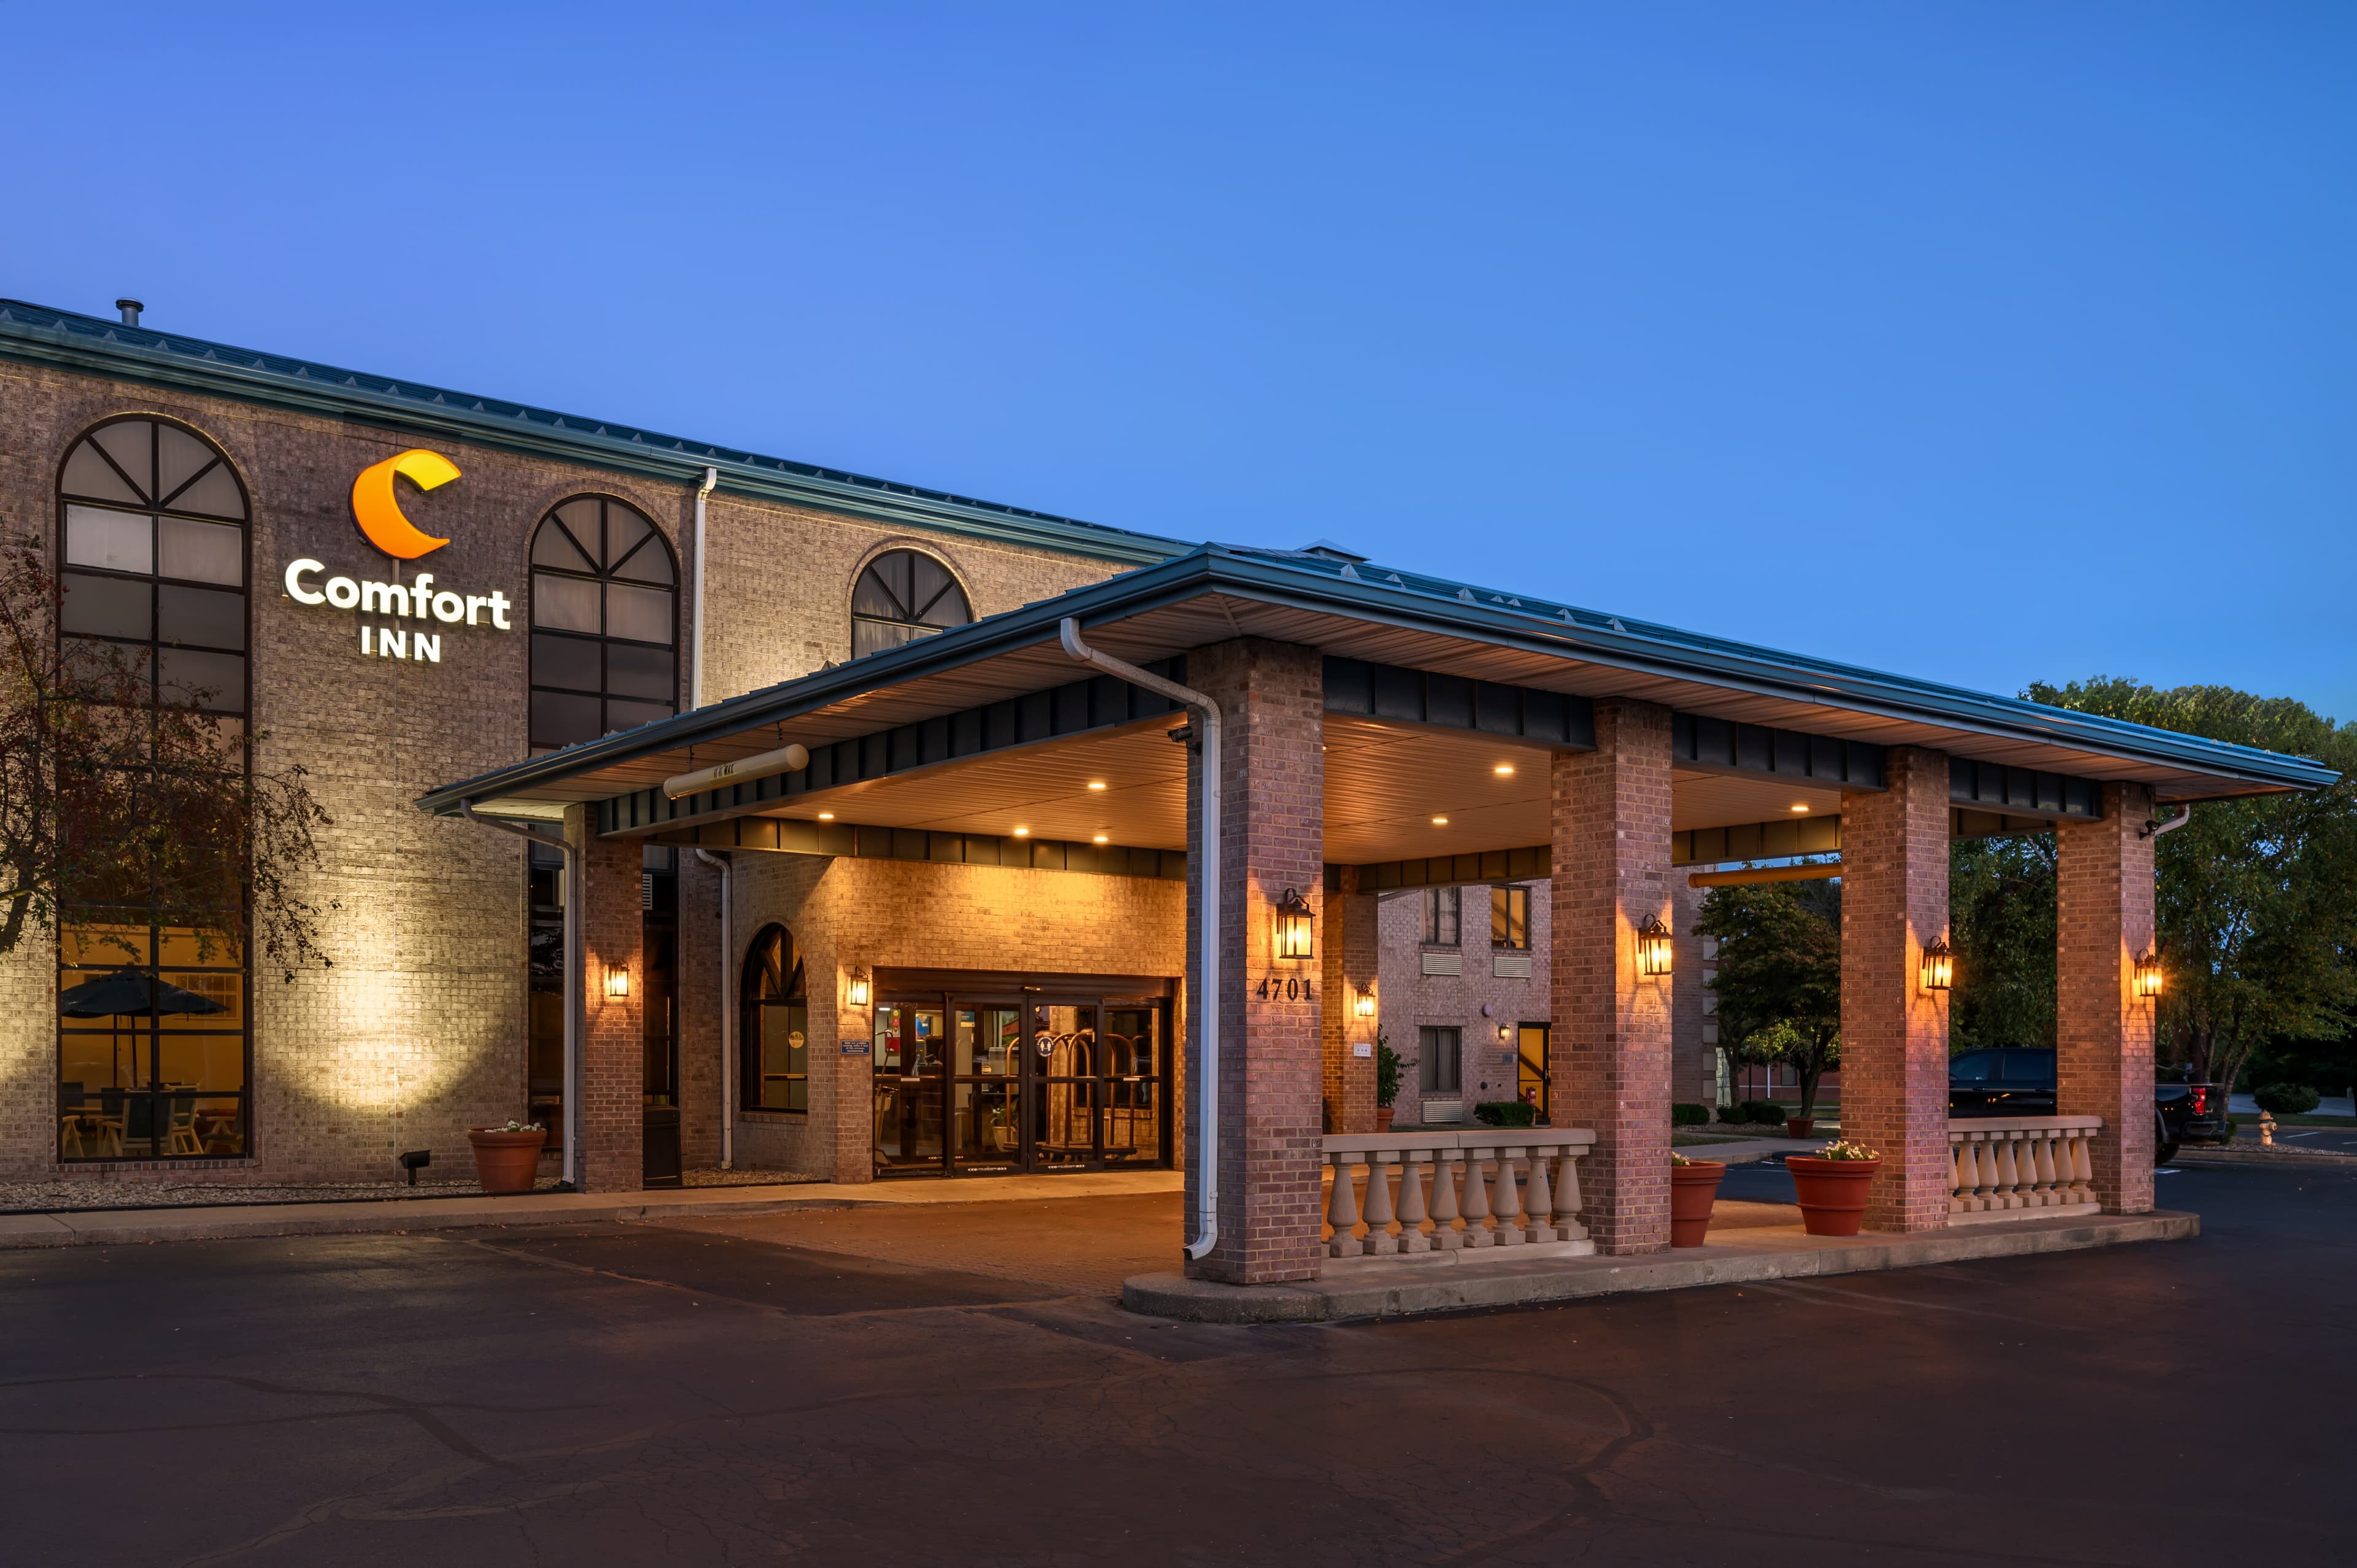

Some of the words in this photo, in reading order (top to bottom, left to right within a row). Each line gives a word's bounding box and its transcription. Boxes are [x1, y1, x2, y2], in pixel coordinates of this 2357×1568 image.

[284, 558, 511, 630] Comfort
[360, 626, 440, 663] INN
[1256, 978, 1312, 1001] 4701
